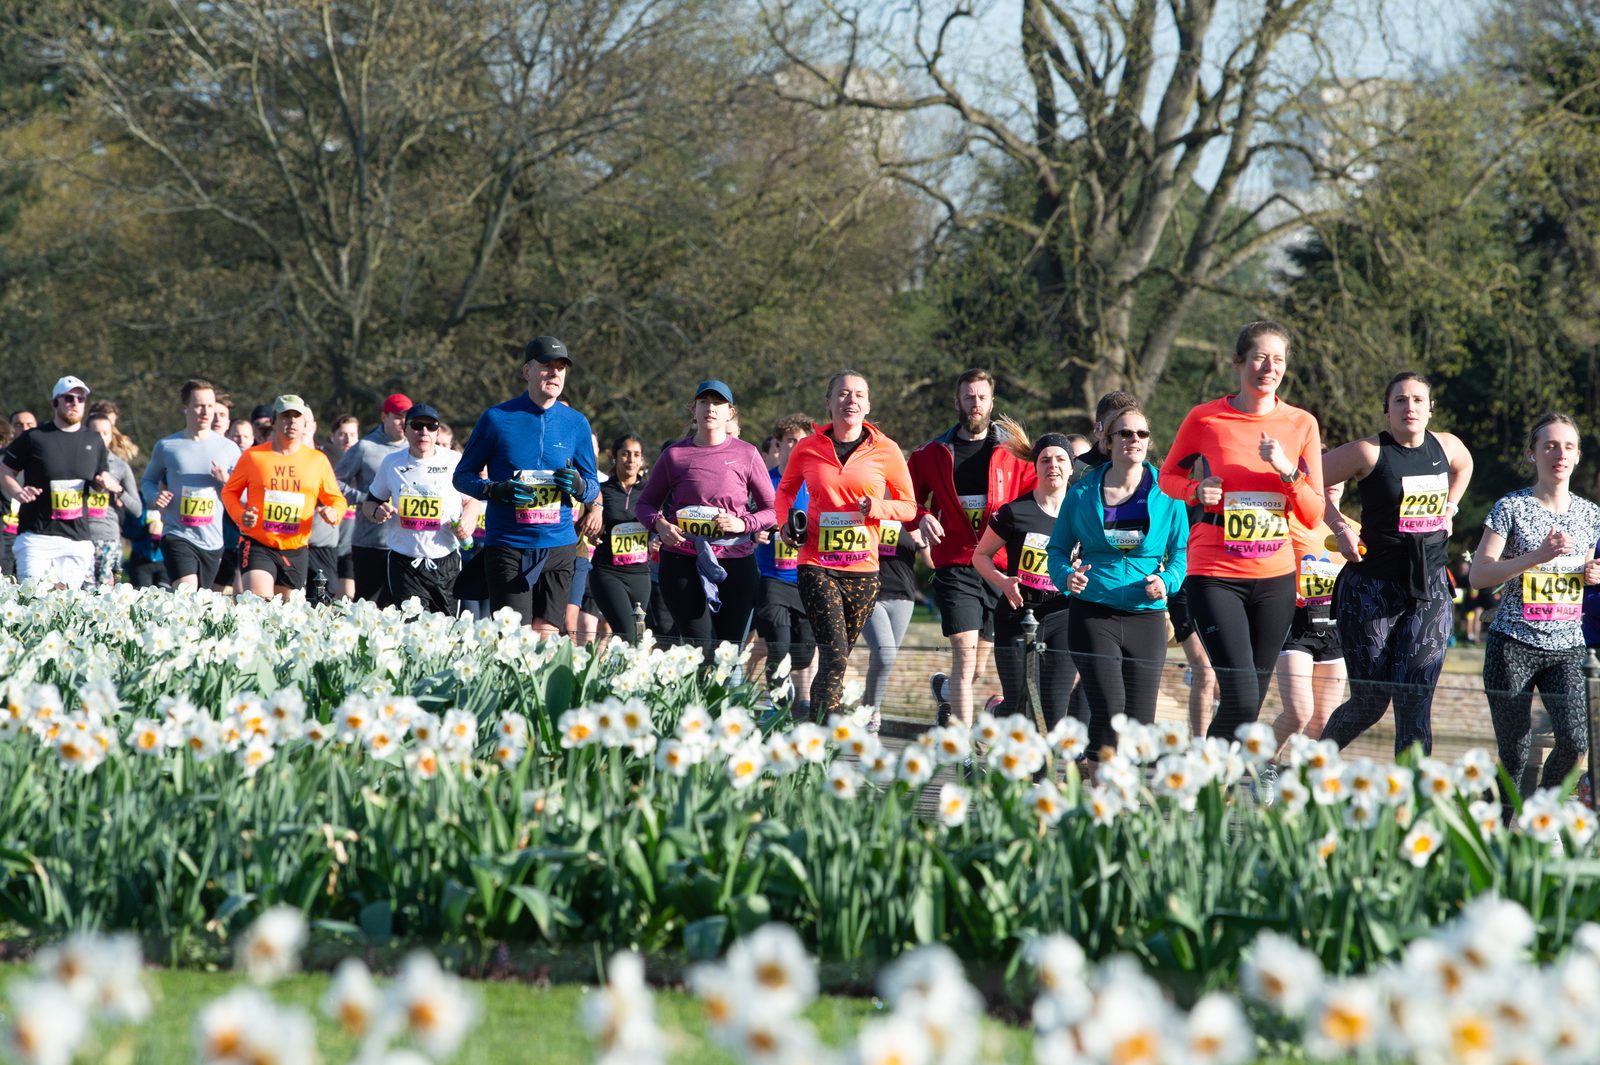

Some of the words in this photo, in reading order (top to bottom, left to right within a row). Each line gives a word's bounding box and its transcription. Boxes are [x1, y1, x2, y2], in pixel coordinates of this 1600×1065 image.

[274, 465, 296, 477] WE
[271, 478, 301, 492] RUN
[184, 499, 214, 515] 1749
[403, 499, 439, 517] 1205
[1403, 492, 1447, 515] 2287
[267, 504, 299, 522] 1091
[1228, 513, 1284, 539] 0992
[1401, 520, 1424, 528] KEW
[614, 534, 647, 553] 2006
[824, 529, 868, 550] 1594
[845, 552, 868, 561] HALF
[1022, 550, 1049, 574] 07
[1531, 577, 1581, 601] 1490
[1526, 607, 1553, 615] KEW
[1556, 607, 1579, 615] HALF
